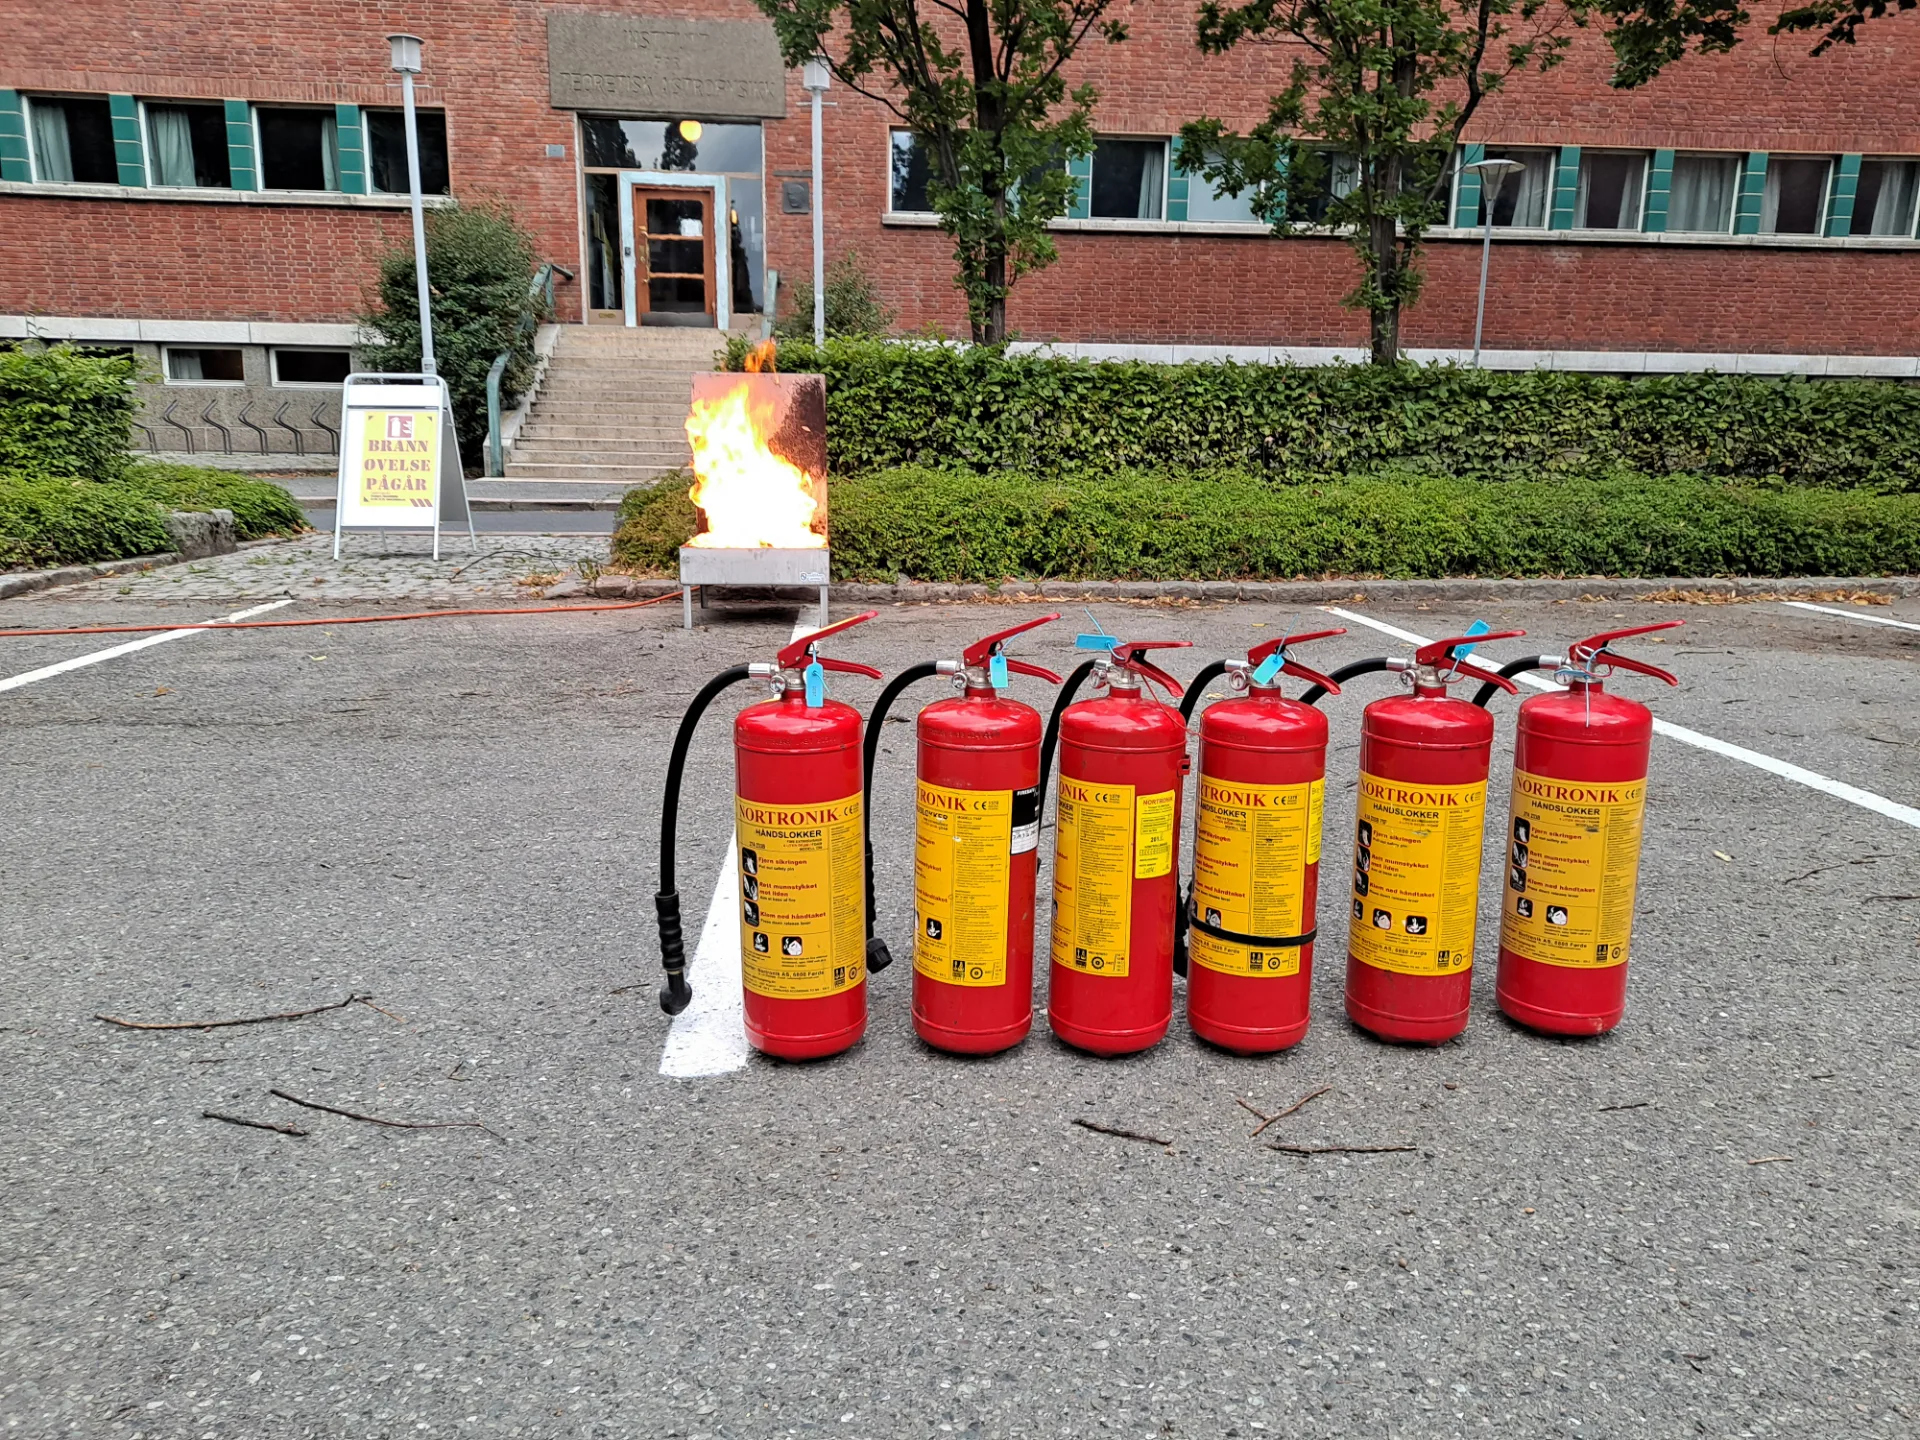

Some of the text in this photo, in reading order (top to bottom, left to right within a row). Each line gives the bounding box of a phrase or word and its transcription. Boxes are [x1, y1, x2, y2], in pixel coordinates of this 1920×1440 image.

[559, 71, 653, 95] TEORETISK
[661, 76, 776, 99] ASTROFYSIKK
[368, 439, 429, 453] BRANN
[366, 474, 427, 491] PÅGÅR
[1361, 778, 1459, 806] NORTRONIK
[1517, 776, 1619, 803] NORTRONIK
[739, 804, 839, 826] NORTRONIK
[1531, 800, 1600, 815] HÅNDSLOKKER
[1373, 829, 1422, 844] Fjern sikringen
[1531, 826, 1582, 840] Fjern sikringen
[1384, 858, 1429, 869] munnstykket
[1529, 850, 1590, 865] Rett munnstykket
[1542, 860, 1559, 868] ilden
[759, 881, 772, 889] Rett
[1213, 886, 1246, 898] håndtaket
[1369, 882, 1384, 891] Klem
[1399, 889, 1435, 898] håndtaket
[1527, 878, 1596, 893] Klem ned håndtaket
[760, 911, 776, 919] Klem
[791, 911, 826, 919] håndtaket
